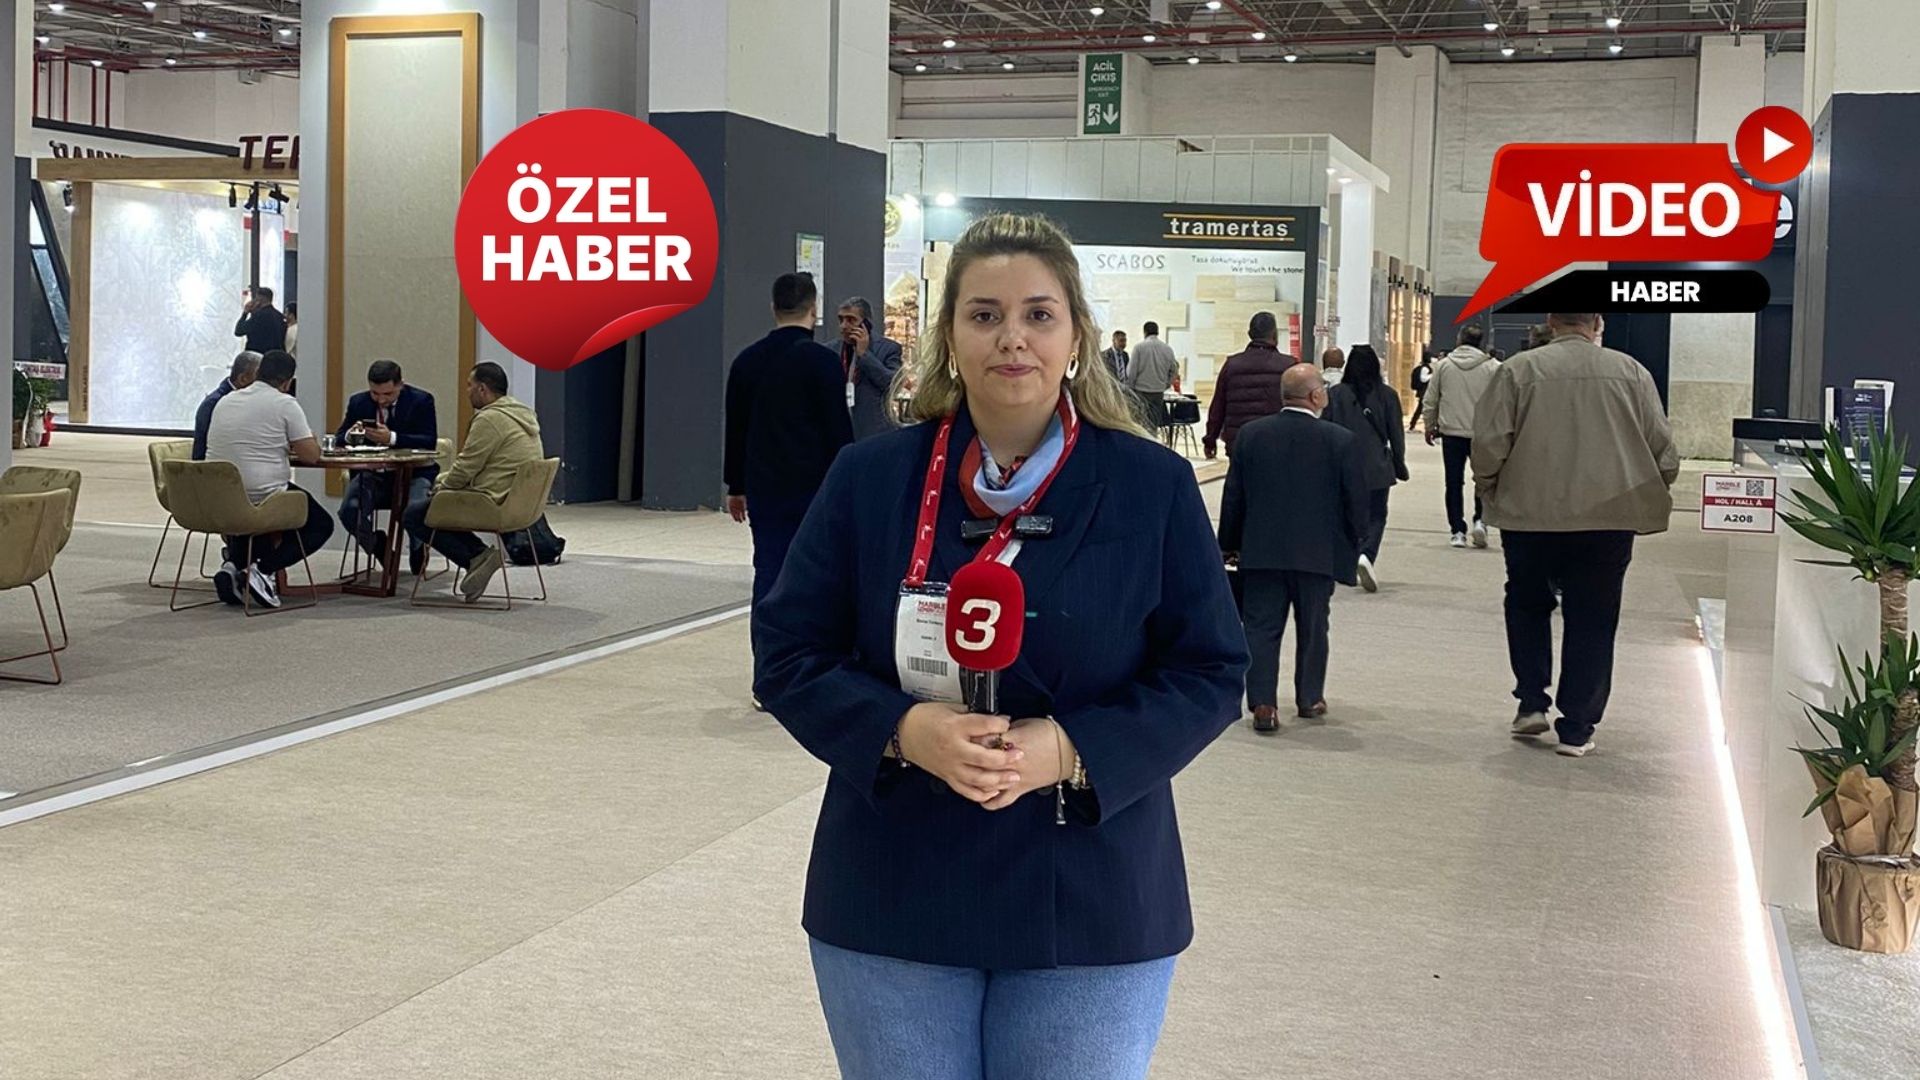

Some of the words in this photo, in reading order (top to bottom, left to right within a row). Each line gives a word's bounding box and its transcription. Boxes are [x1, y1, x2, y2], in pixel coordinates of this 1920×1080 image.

[1093, 60, 1115, 71] ACİL
[1090, 72, 1116, 83] ÇIKIŞ
[1170, 217, 1289, 237] tramertas
[1096, 253, 1166, 269] SCABOS
[1268, 265, 1281, 273] the
[1723, 514, 1753, 523] A208
[955, 598, 1002, 651] 3
